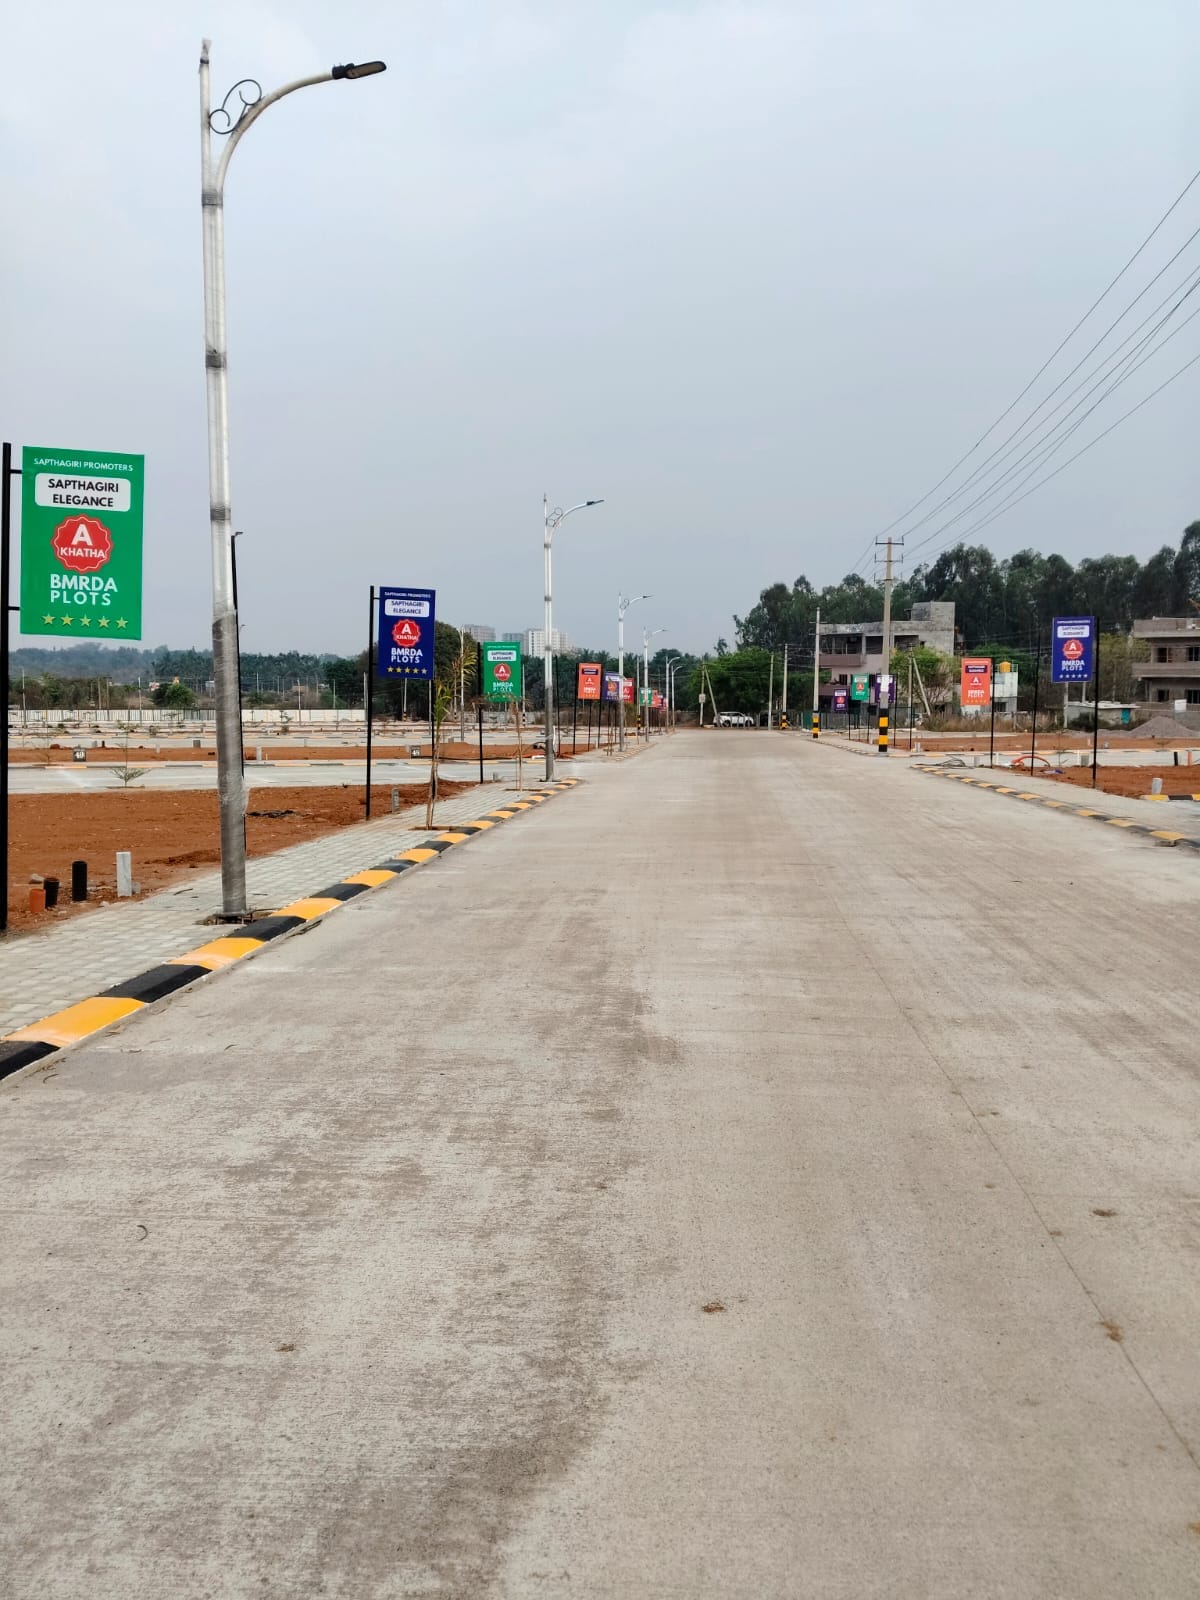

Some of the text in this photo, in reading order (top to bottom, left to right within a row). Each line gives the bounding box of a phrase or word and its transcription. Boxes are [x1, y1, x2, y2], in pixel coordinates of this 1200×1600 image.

[34, 457, 134, 472] SAPTHAGIRI PROMOTERS
[48, 478, 119, 493] SAPTHAGIRI
[52, 493, 114, 508] ELEGANCE
[71, 523, 94, 547] A
[60, 546, 106, 559] KHATHA
[50, 573, 119, 593] BMRDA
[50, 590, 112, 606] PLOTS
[392, 607, 422, 615] ELEGANCE
[401, 623, 412, 635] A
[390, 647, 423, 657] BMRDA
[1069, 642, 1077, 651] A
[390, 655, 420, 664] PLOTS
[498, 665, 506, 674] A
[1061, 664, 1084, 672] PLOTS
